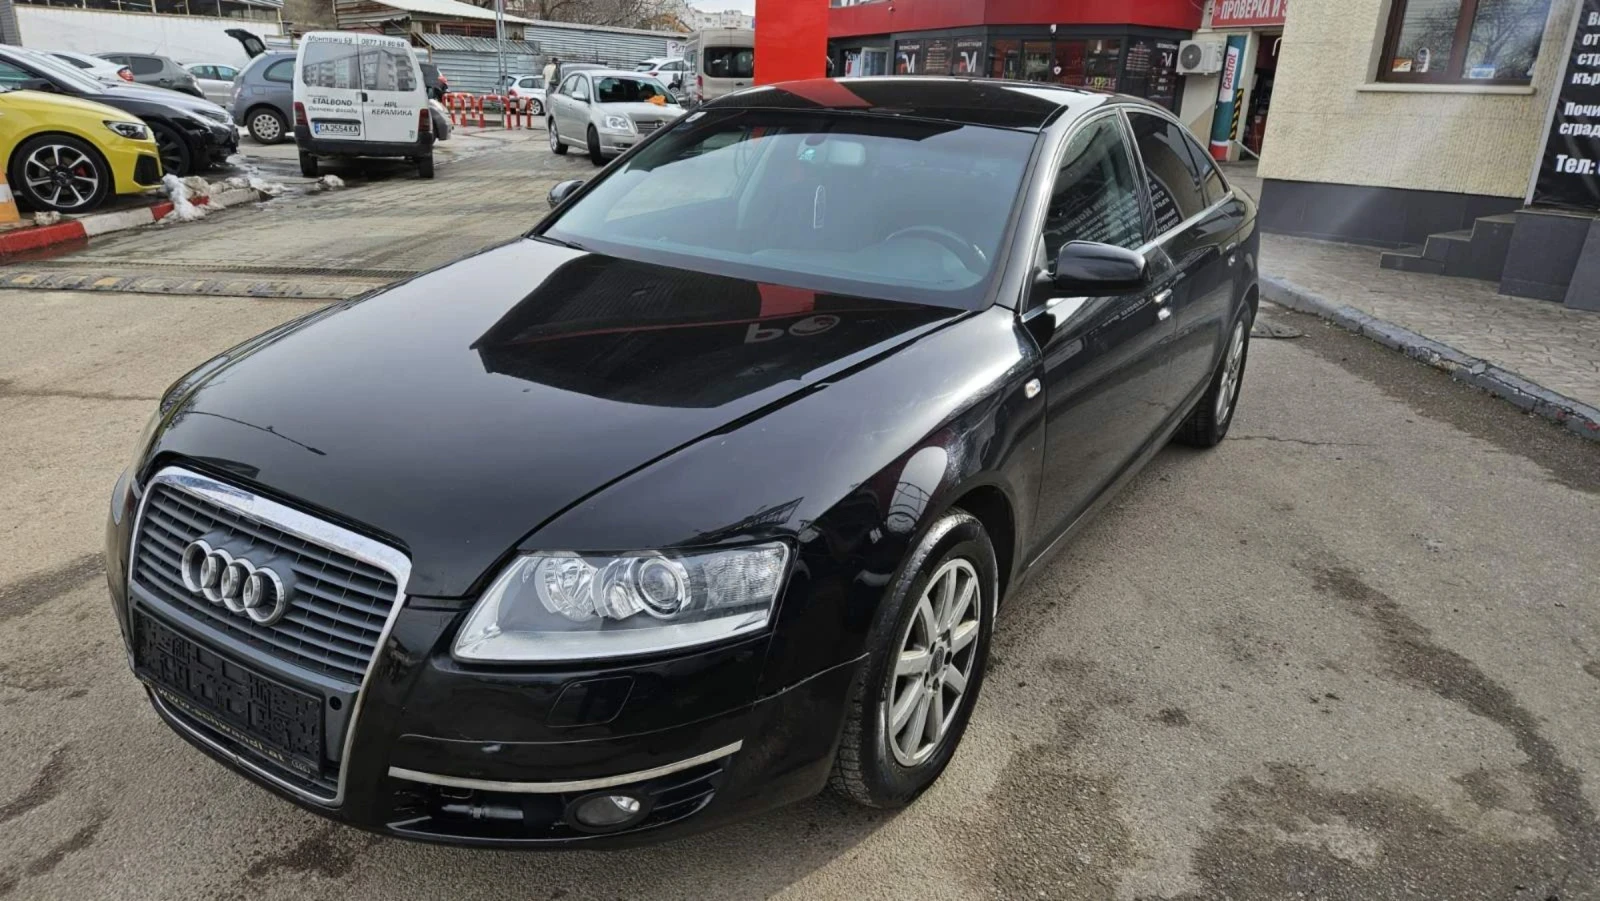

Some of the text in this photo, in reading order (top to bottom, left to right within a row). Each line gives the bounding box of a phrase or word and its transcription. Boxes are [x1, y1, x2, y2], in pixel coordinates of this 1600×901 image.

[1220, 0, 1270, 19] ПРОВЕРКА
[1272, 0, 1281, 18] И
[1587, 11, 1600, 26] В
[1222, 53, 1237, 90] Castrol
[312, 97, 353, 106] ETALBOND
[371, 108, 413, 116] КЕРАМИКА
[1555, 154, 1596, 175] Тел:
